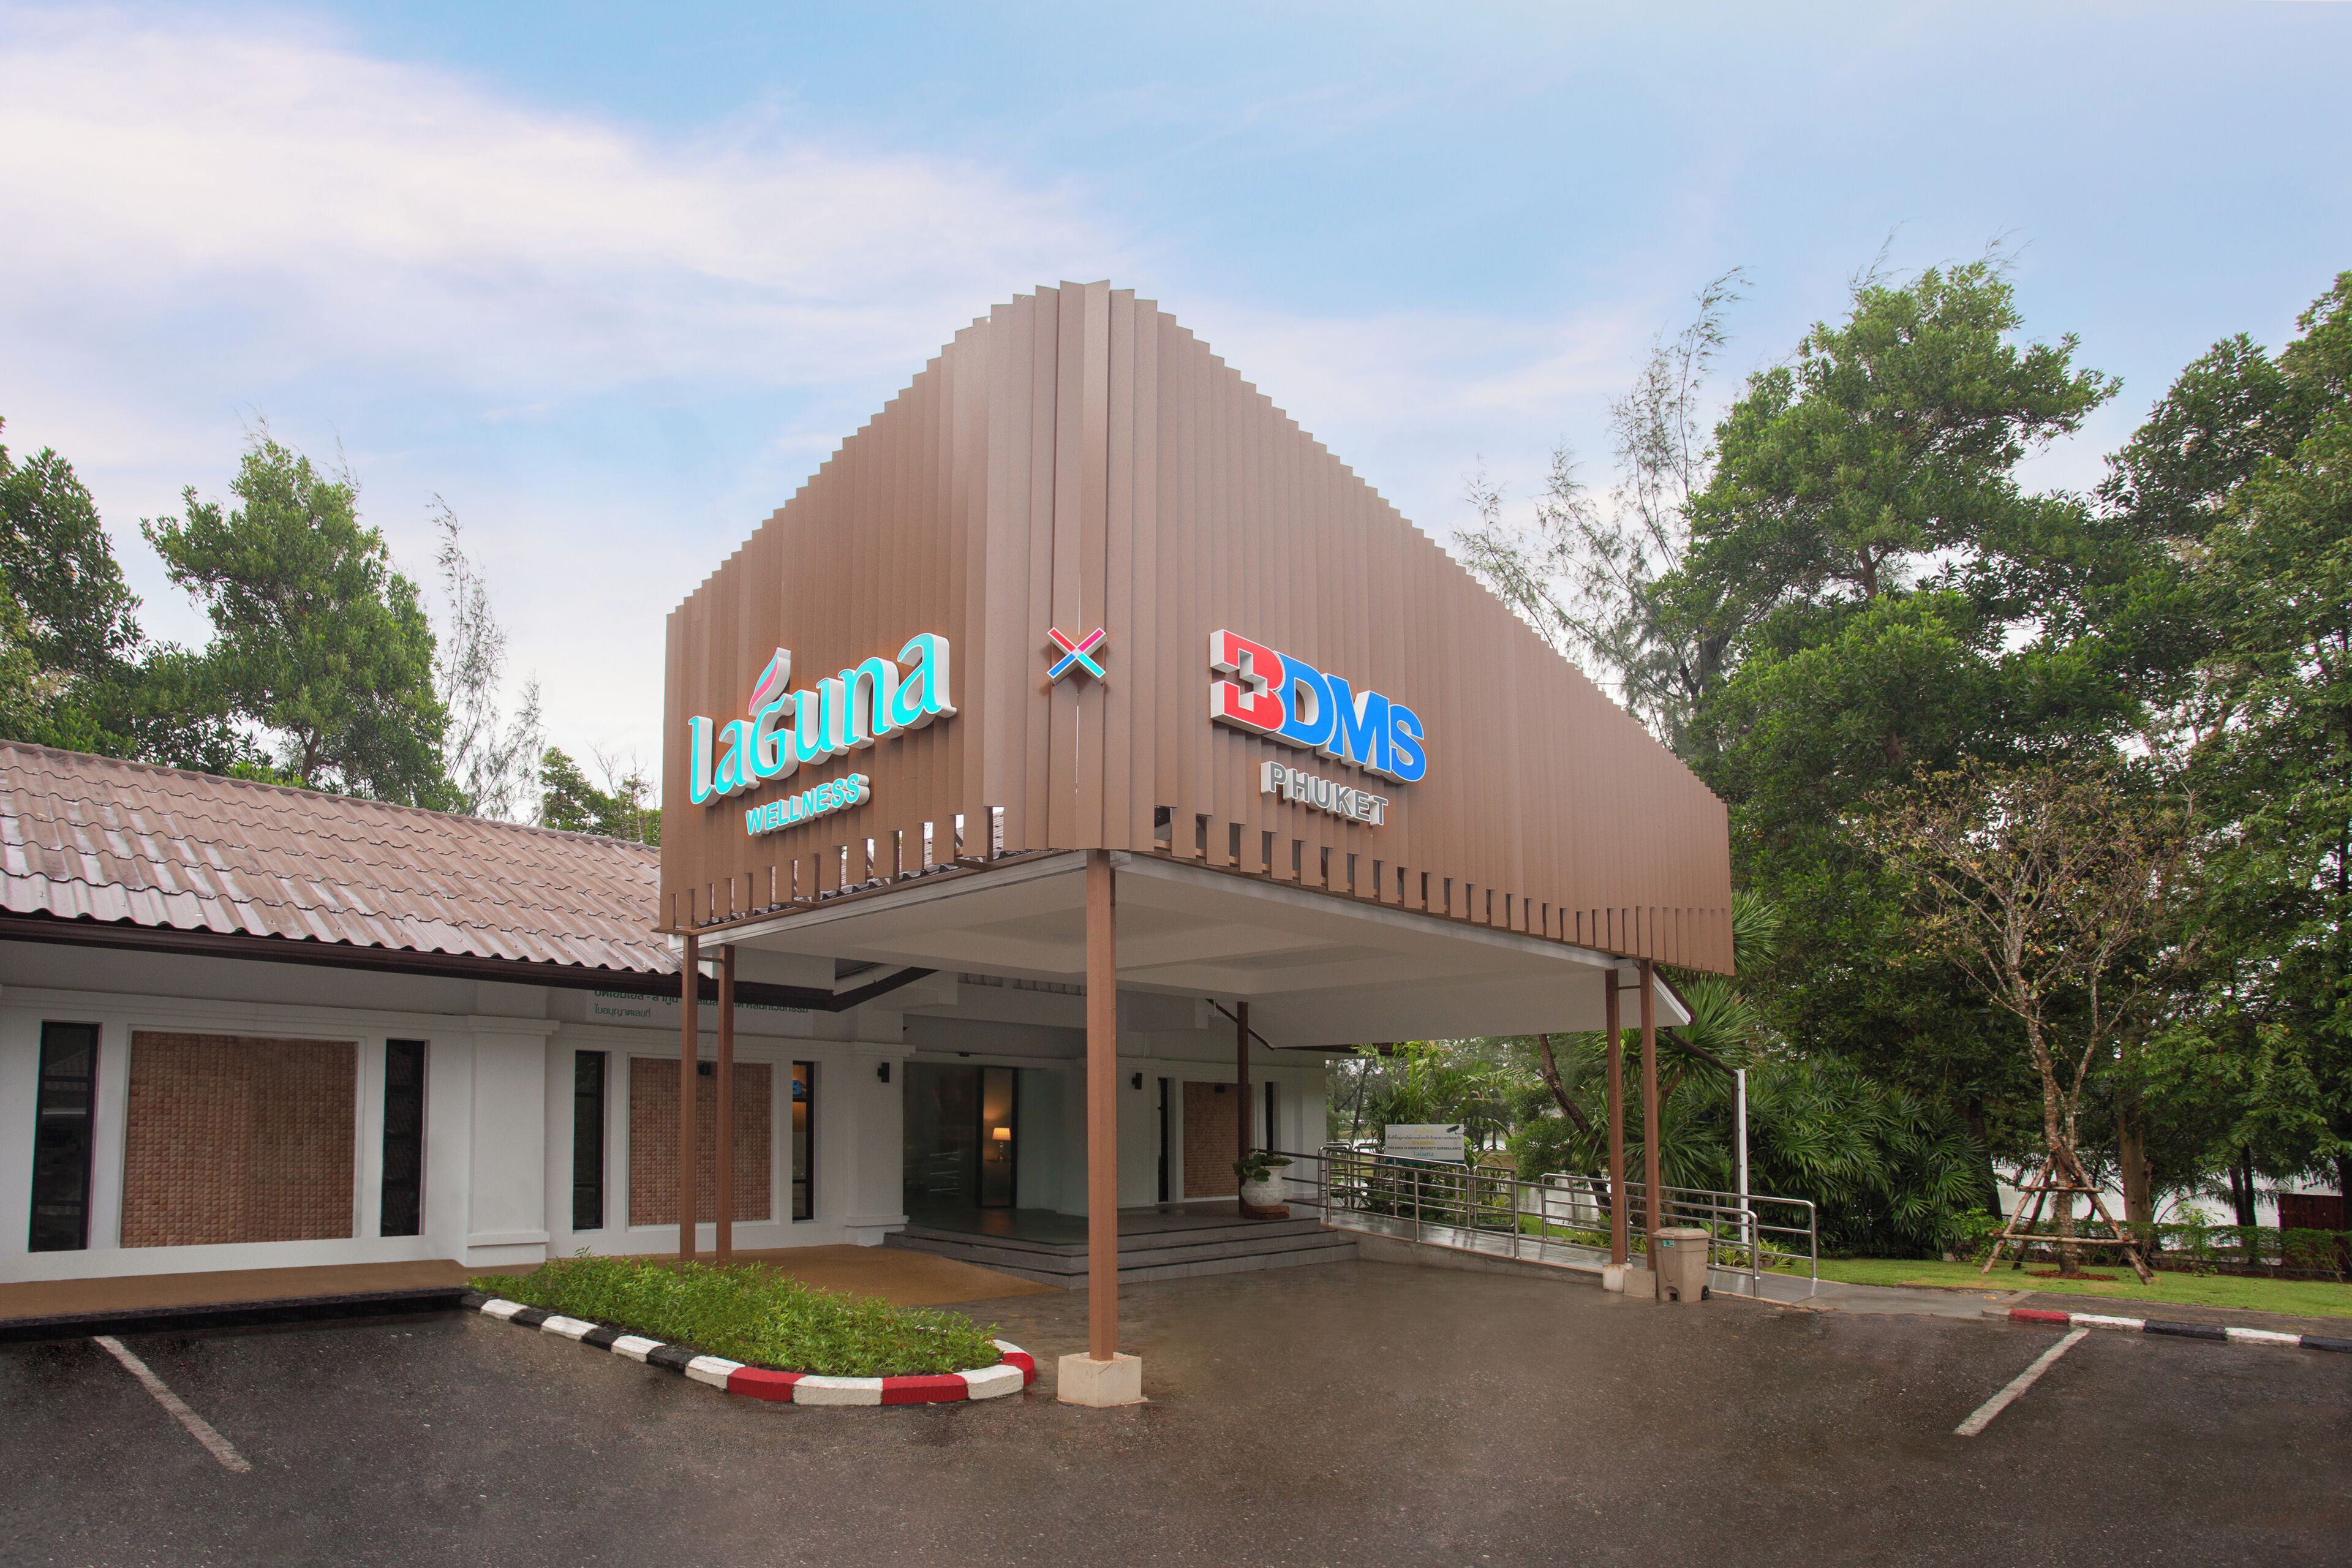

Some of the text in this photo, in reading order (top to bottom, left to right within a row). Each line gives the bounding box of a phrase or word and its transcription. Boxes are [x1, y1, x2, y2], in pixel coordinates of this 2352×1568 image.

[1212, 629, 1427, 783] BDMS
[745, 774, 867, 837] WELLNESS
[1262, 761, 1389, 826] PHUKET
[594, 1003, 651, 1017] ใบอนุญาตเลขที่
